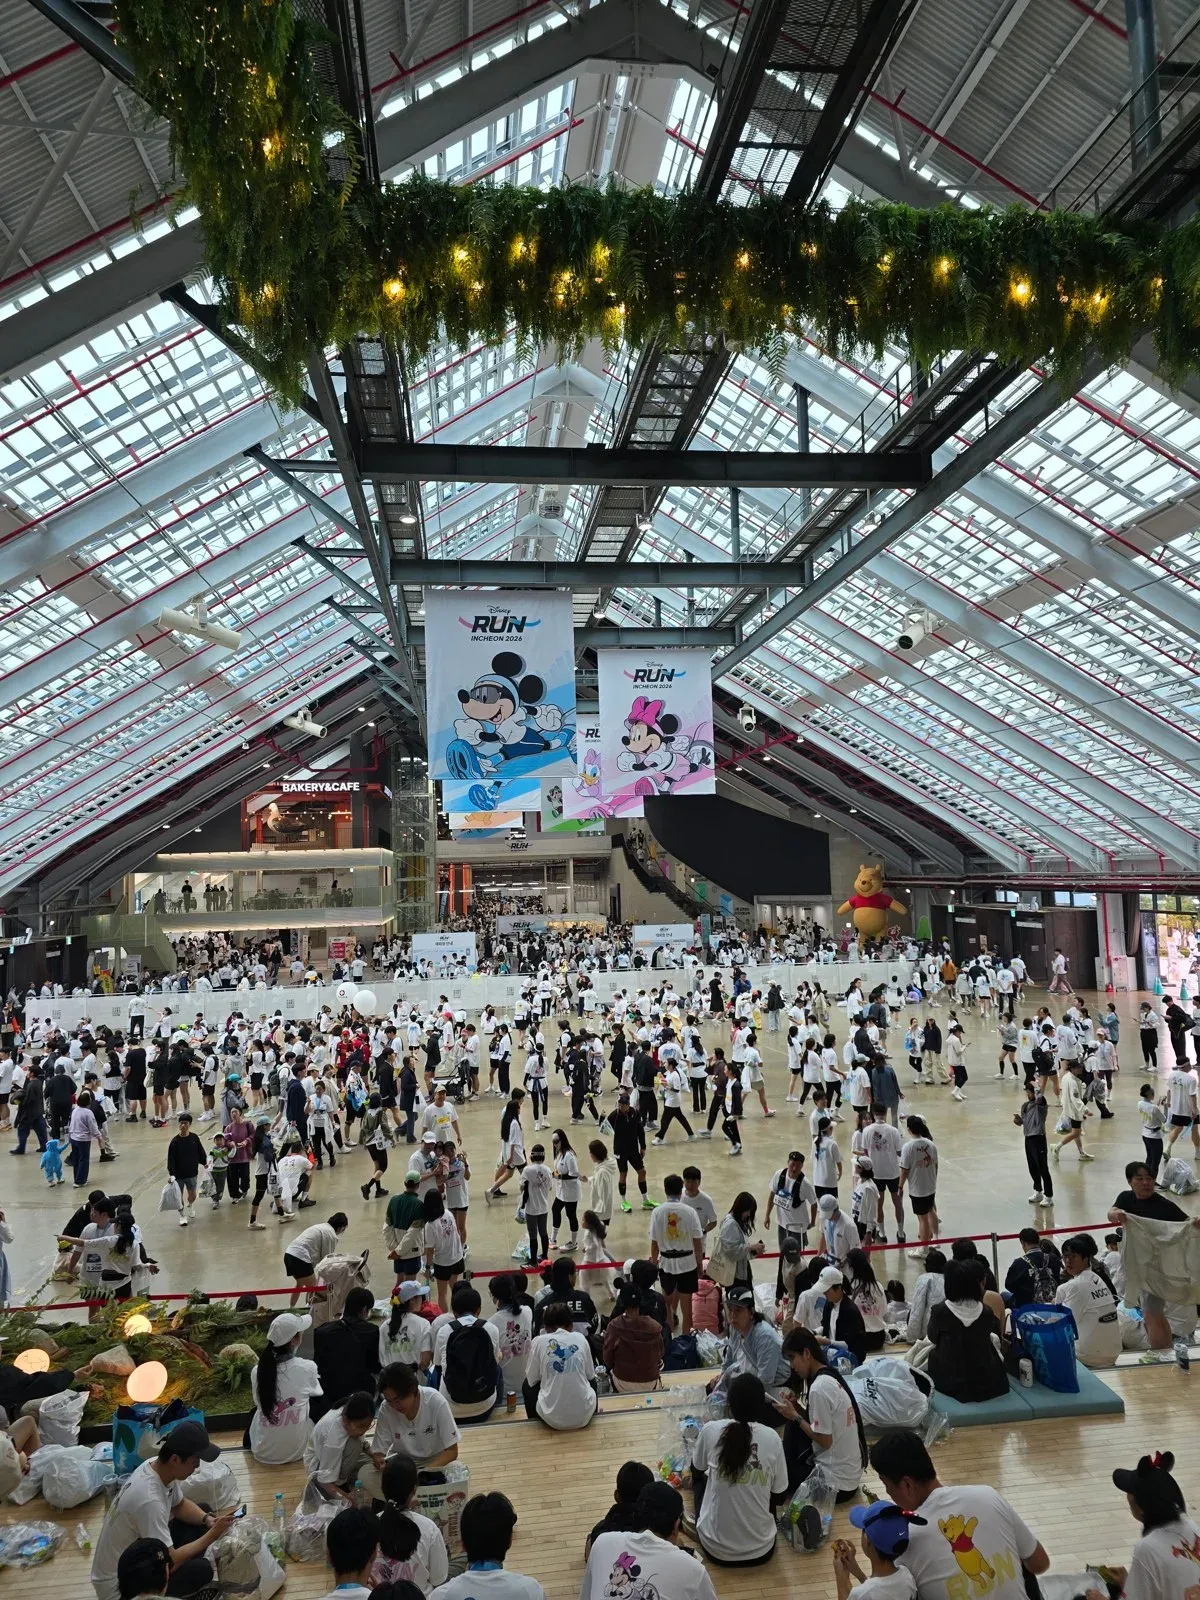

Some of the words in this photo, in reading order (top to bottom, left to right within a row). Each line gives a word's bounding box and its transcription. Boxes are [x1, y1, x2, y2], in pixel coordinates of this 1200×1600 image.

[487, 605, 511, 614] Disney
[471, 615, 527, 633] RUN
[633, 669, 675, 682] RUN
[282, 782, 360, 792] BAKERY&CAFE
[865, 1378, 879, 1400] RUN
